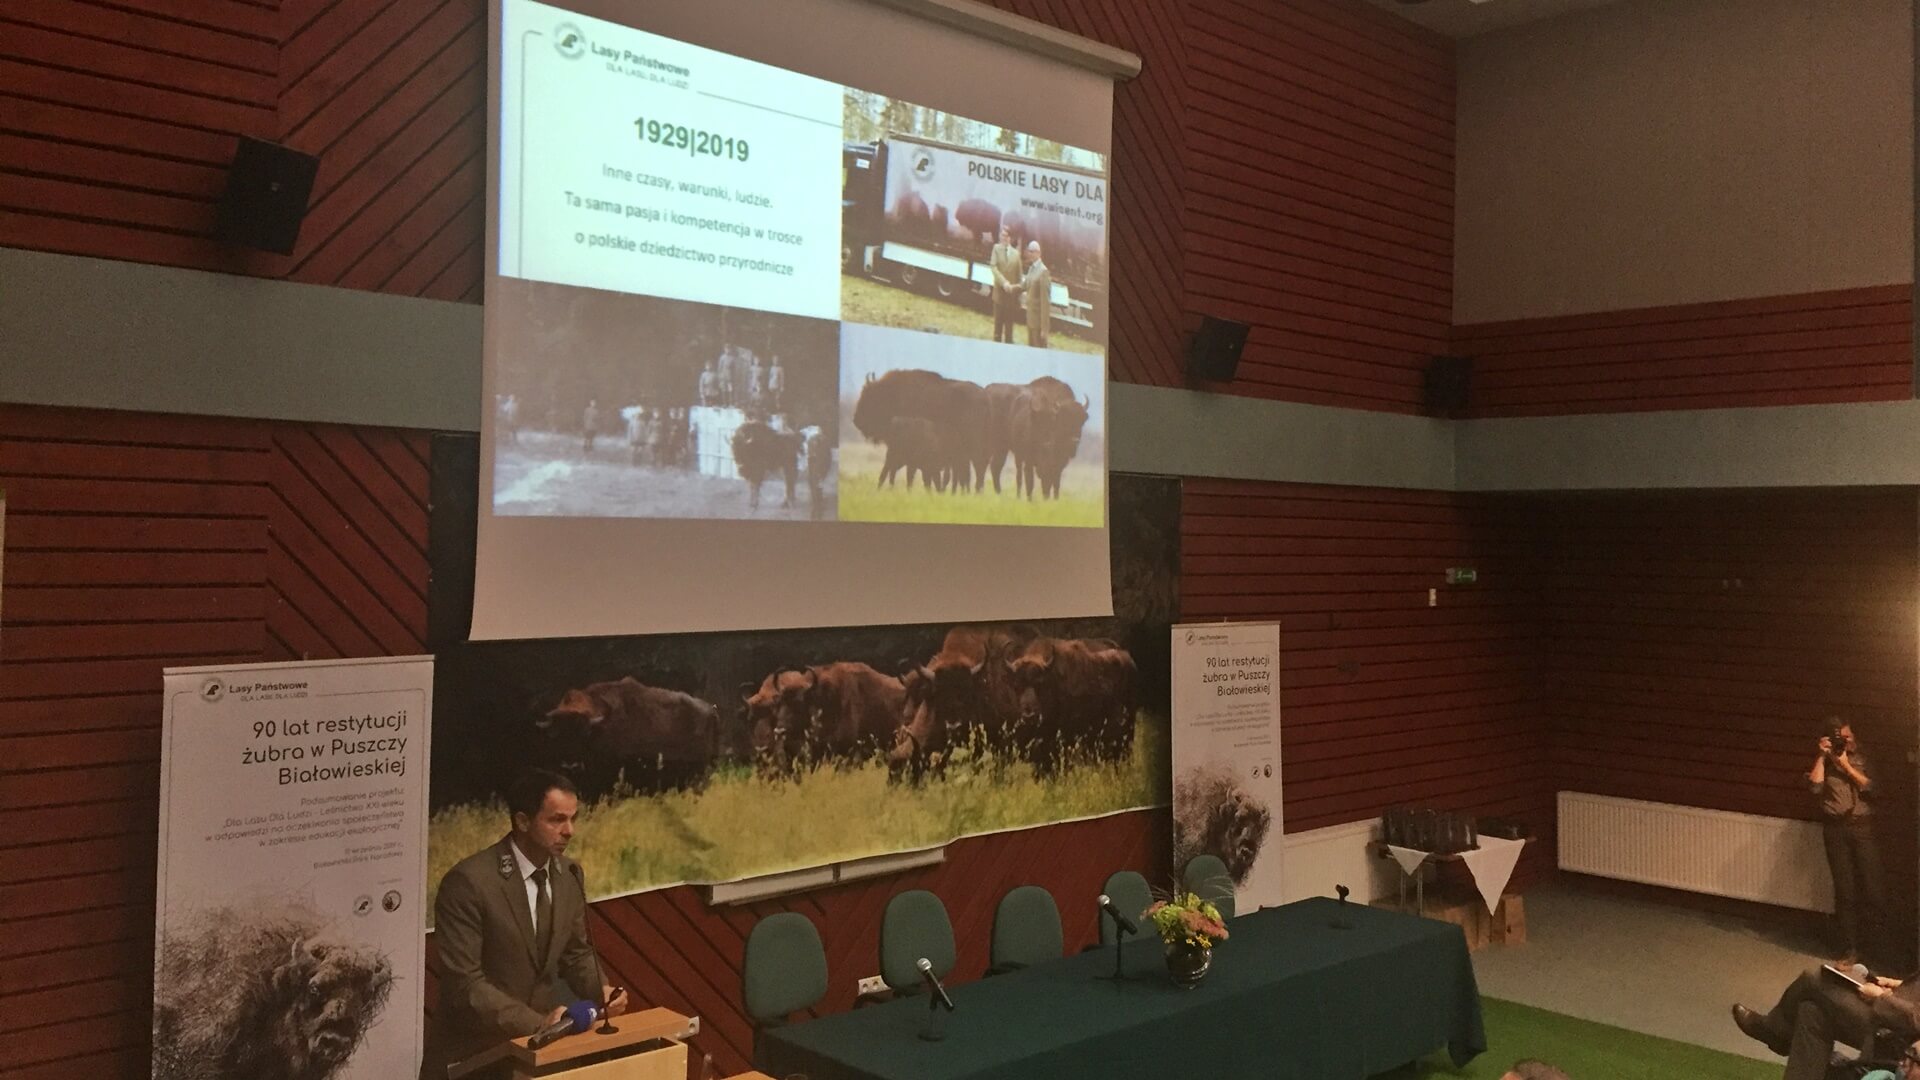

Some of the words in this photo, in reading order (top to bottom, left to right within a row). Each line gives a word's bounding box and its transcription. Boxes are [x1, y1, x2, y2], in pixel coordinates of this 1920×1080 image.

[591, 41, 621, 61] Lasy
[623, 50, 690, 77] Państwowe
[633, 117, 749, 162] 1929|2019
[602, 163, 633, 183] Inne
[636, 171, 675, 192] czasy,
[678, 177, 731, 203] warunki,
[735, 189, 774, 208] ludzie.
[968, 161, 1026, 187] POLSKIE
[1032, 173, 1069, 194] LASY
[1075, 182, 1104, 203] DLA
[565, 191, 582, 208] Ta
[585, 197, 622, 214] sama
[625, 204, 660, 223] pasja
[663, 208, 669, 222] i
[670, 206, 750, 238] kompetencja
[754, 228, 764, 239] w
[768, 228, 803, 246] trosce
[1021, 198, 1104, 226] www.wisent.org
[575, 232, 585, 244] o
[588, 232, 636, 252] polskie
[640, 240, 716, 264] dziedzictwo
[719, 254, 794, 276] przyrodnicze
[1206, 657, 1217, 668] 90
[1218, 656, 1230, 668] lat
[1232, 655, 1270, 668] restytucji
[1230, 673, 1237, 681] w
[1238, 670, 1270, 681] Puszczy
[229, 685, 252, 694] Lasy
[255, 682, 308, 691] Państwowe
[1217, 684, 1271, 696] Białowieskiej
[253, 720, 277, 738] 90
[283, 719, 310, 736] lat
[317, 710, 407, 734] restytucji
[242, 745, 304, 765] żubra
[310, 744, 325, 756] w
[331, 737, 407, 755] Puszczy
[279, 756, 406, 785] Białowieskiej
